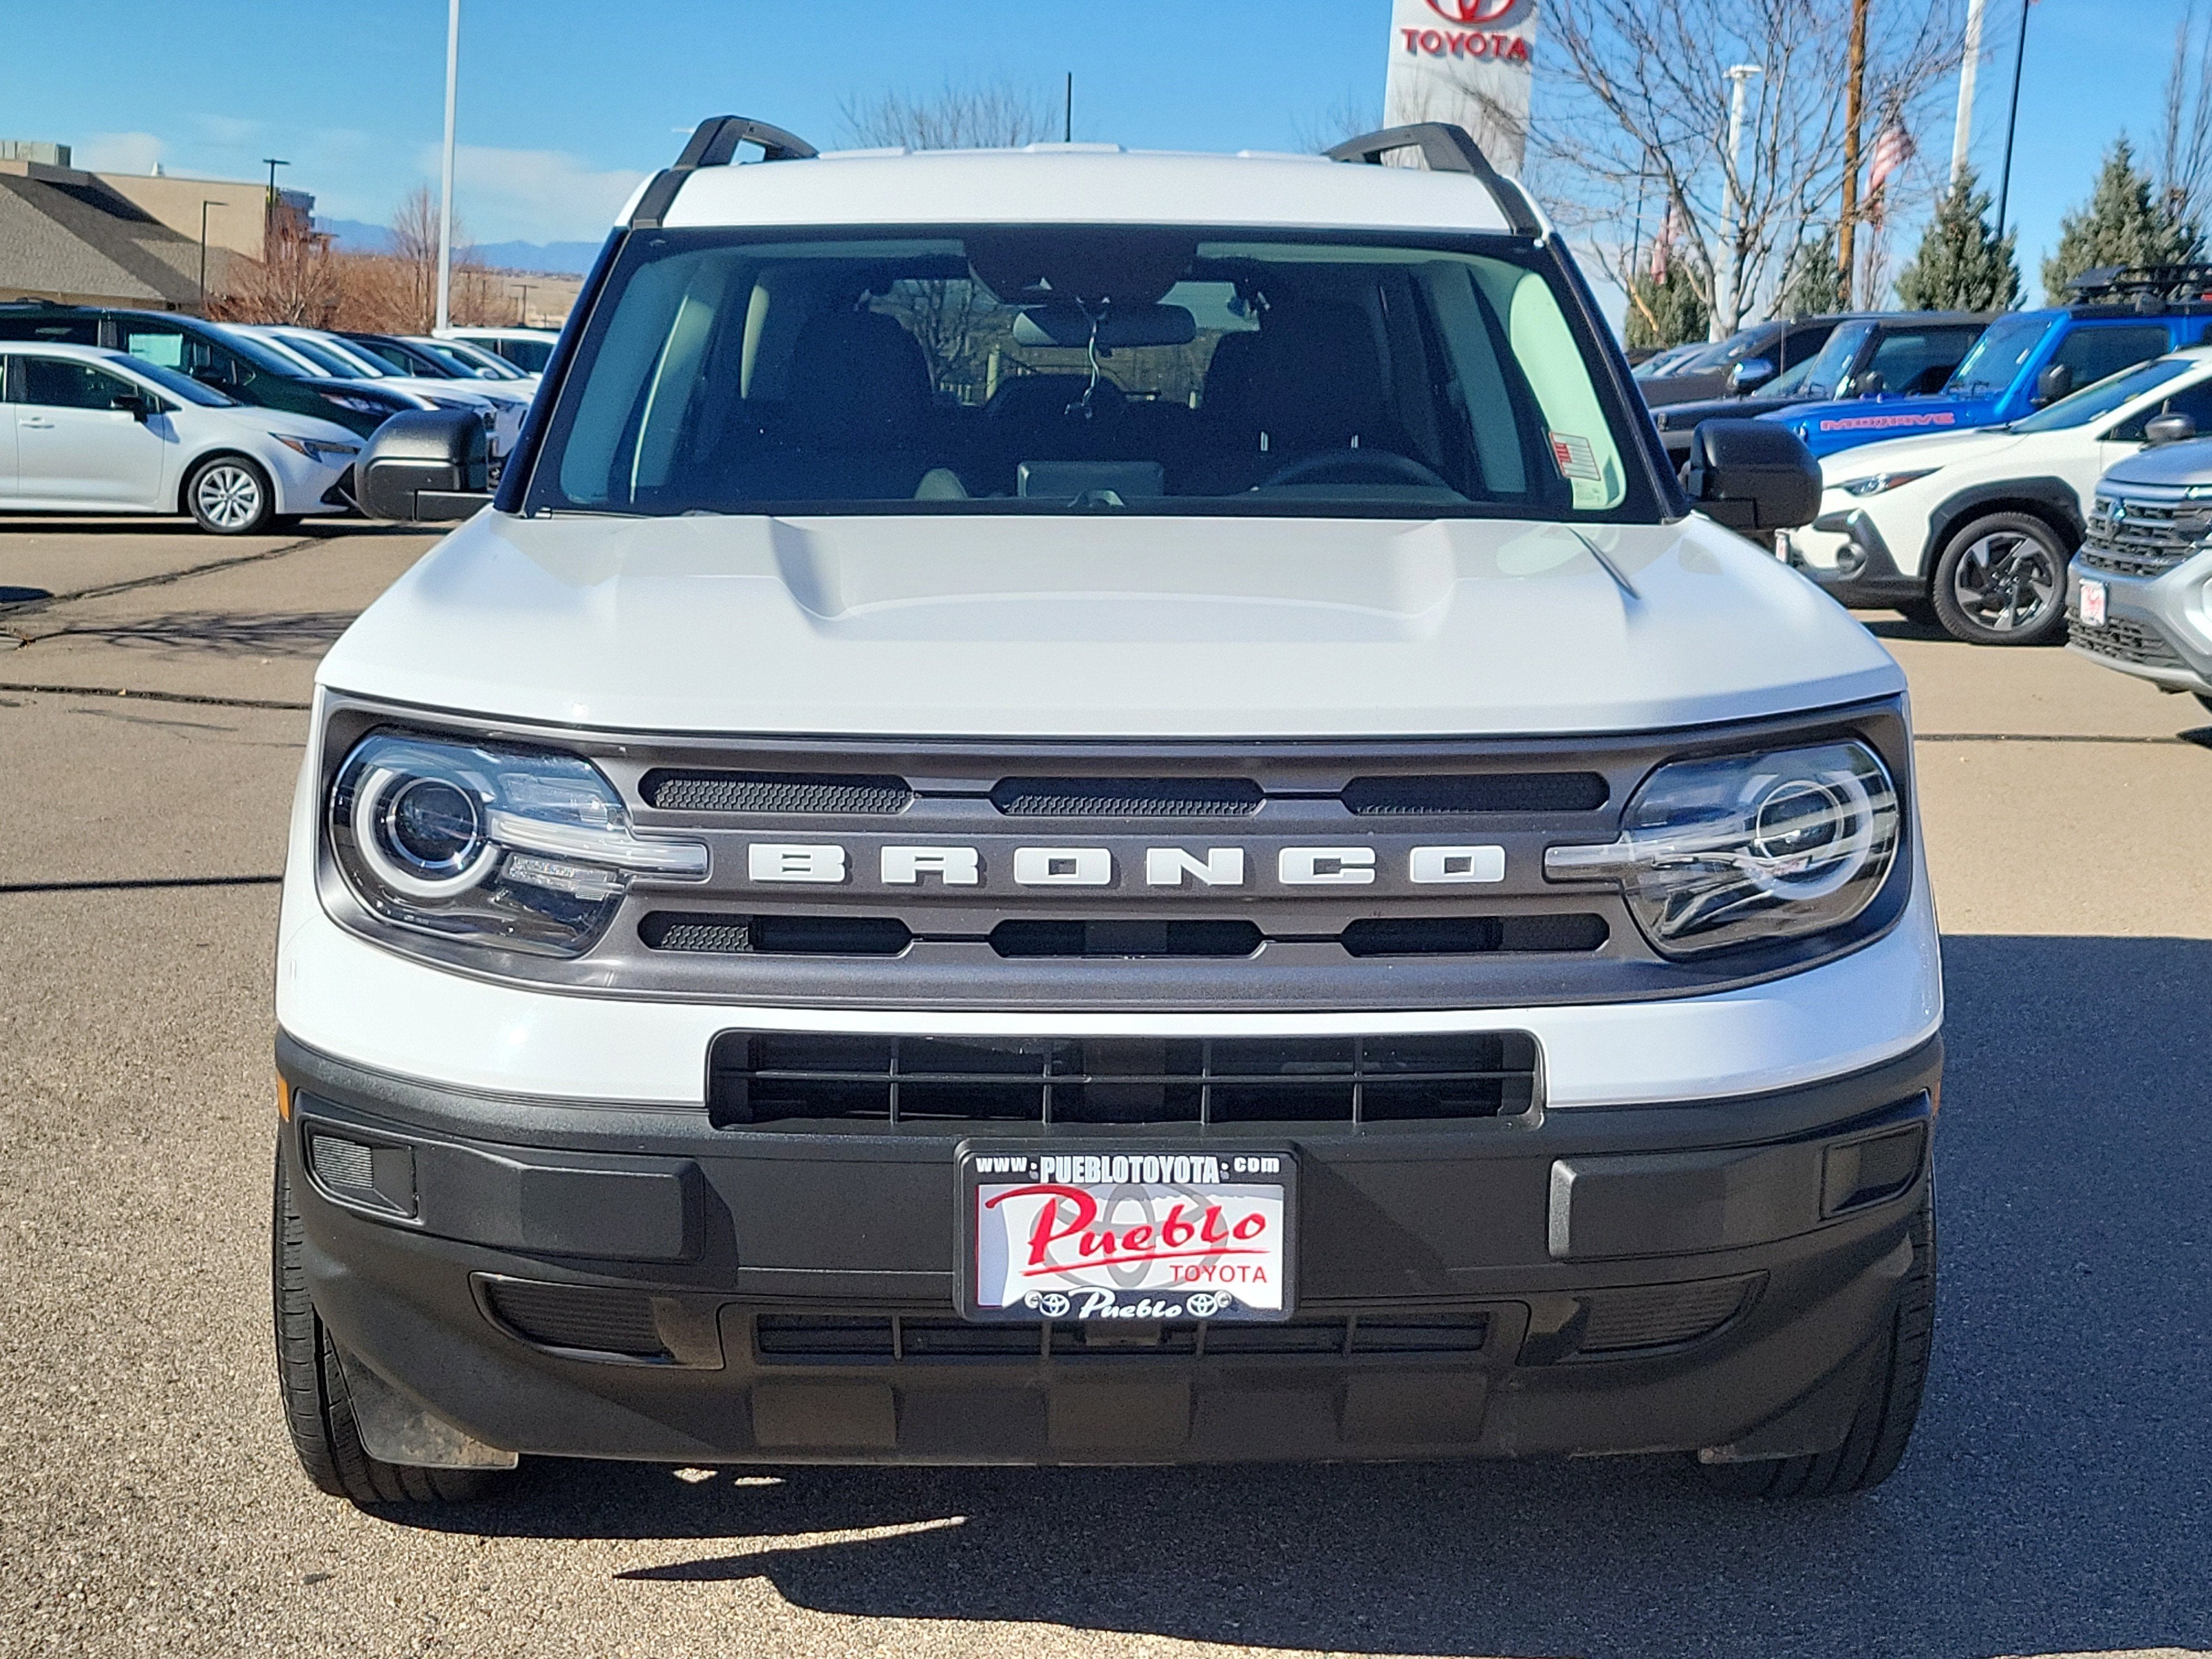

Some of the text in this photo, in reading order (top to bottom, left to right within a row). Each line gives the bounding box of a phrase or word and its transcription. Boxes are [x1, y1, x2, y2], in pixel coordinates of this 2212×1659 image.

[1401, 29, 1528, 61] TOYOTA
[748, 843, 1506, 885] BRONCO
[984, 1184, 1267, 1265] Pueblo
[1169, 1265, 1267, 1284] TOYOTA
[1068, 1286, 1183, 1318] Pueblo
